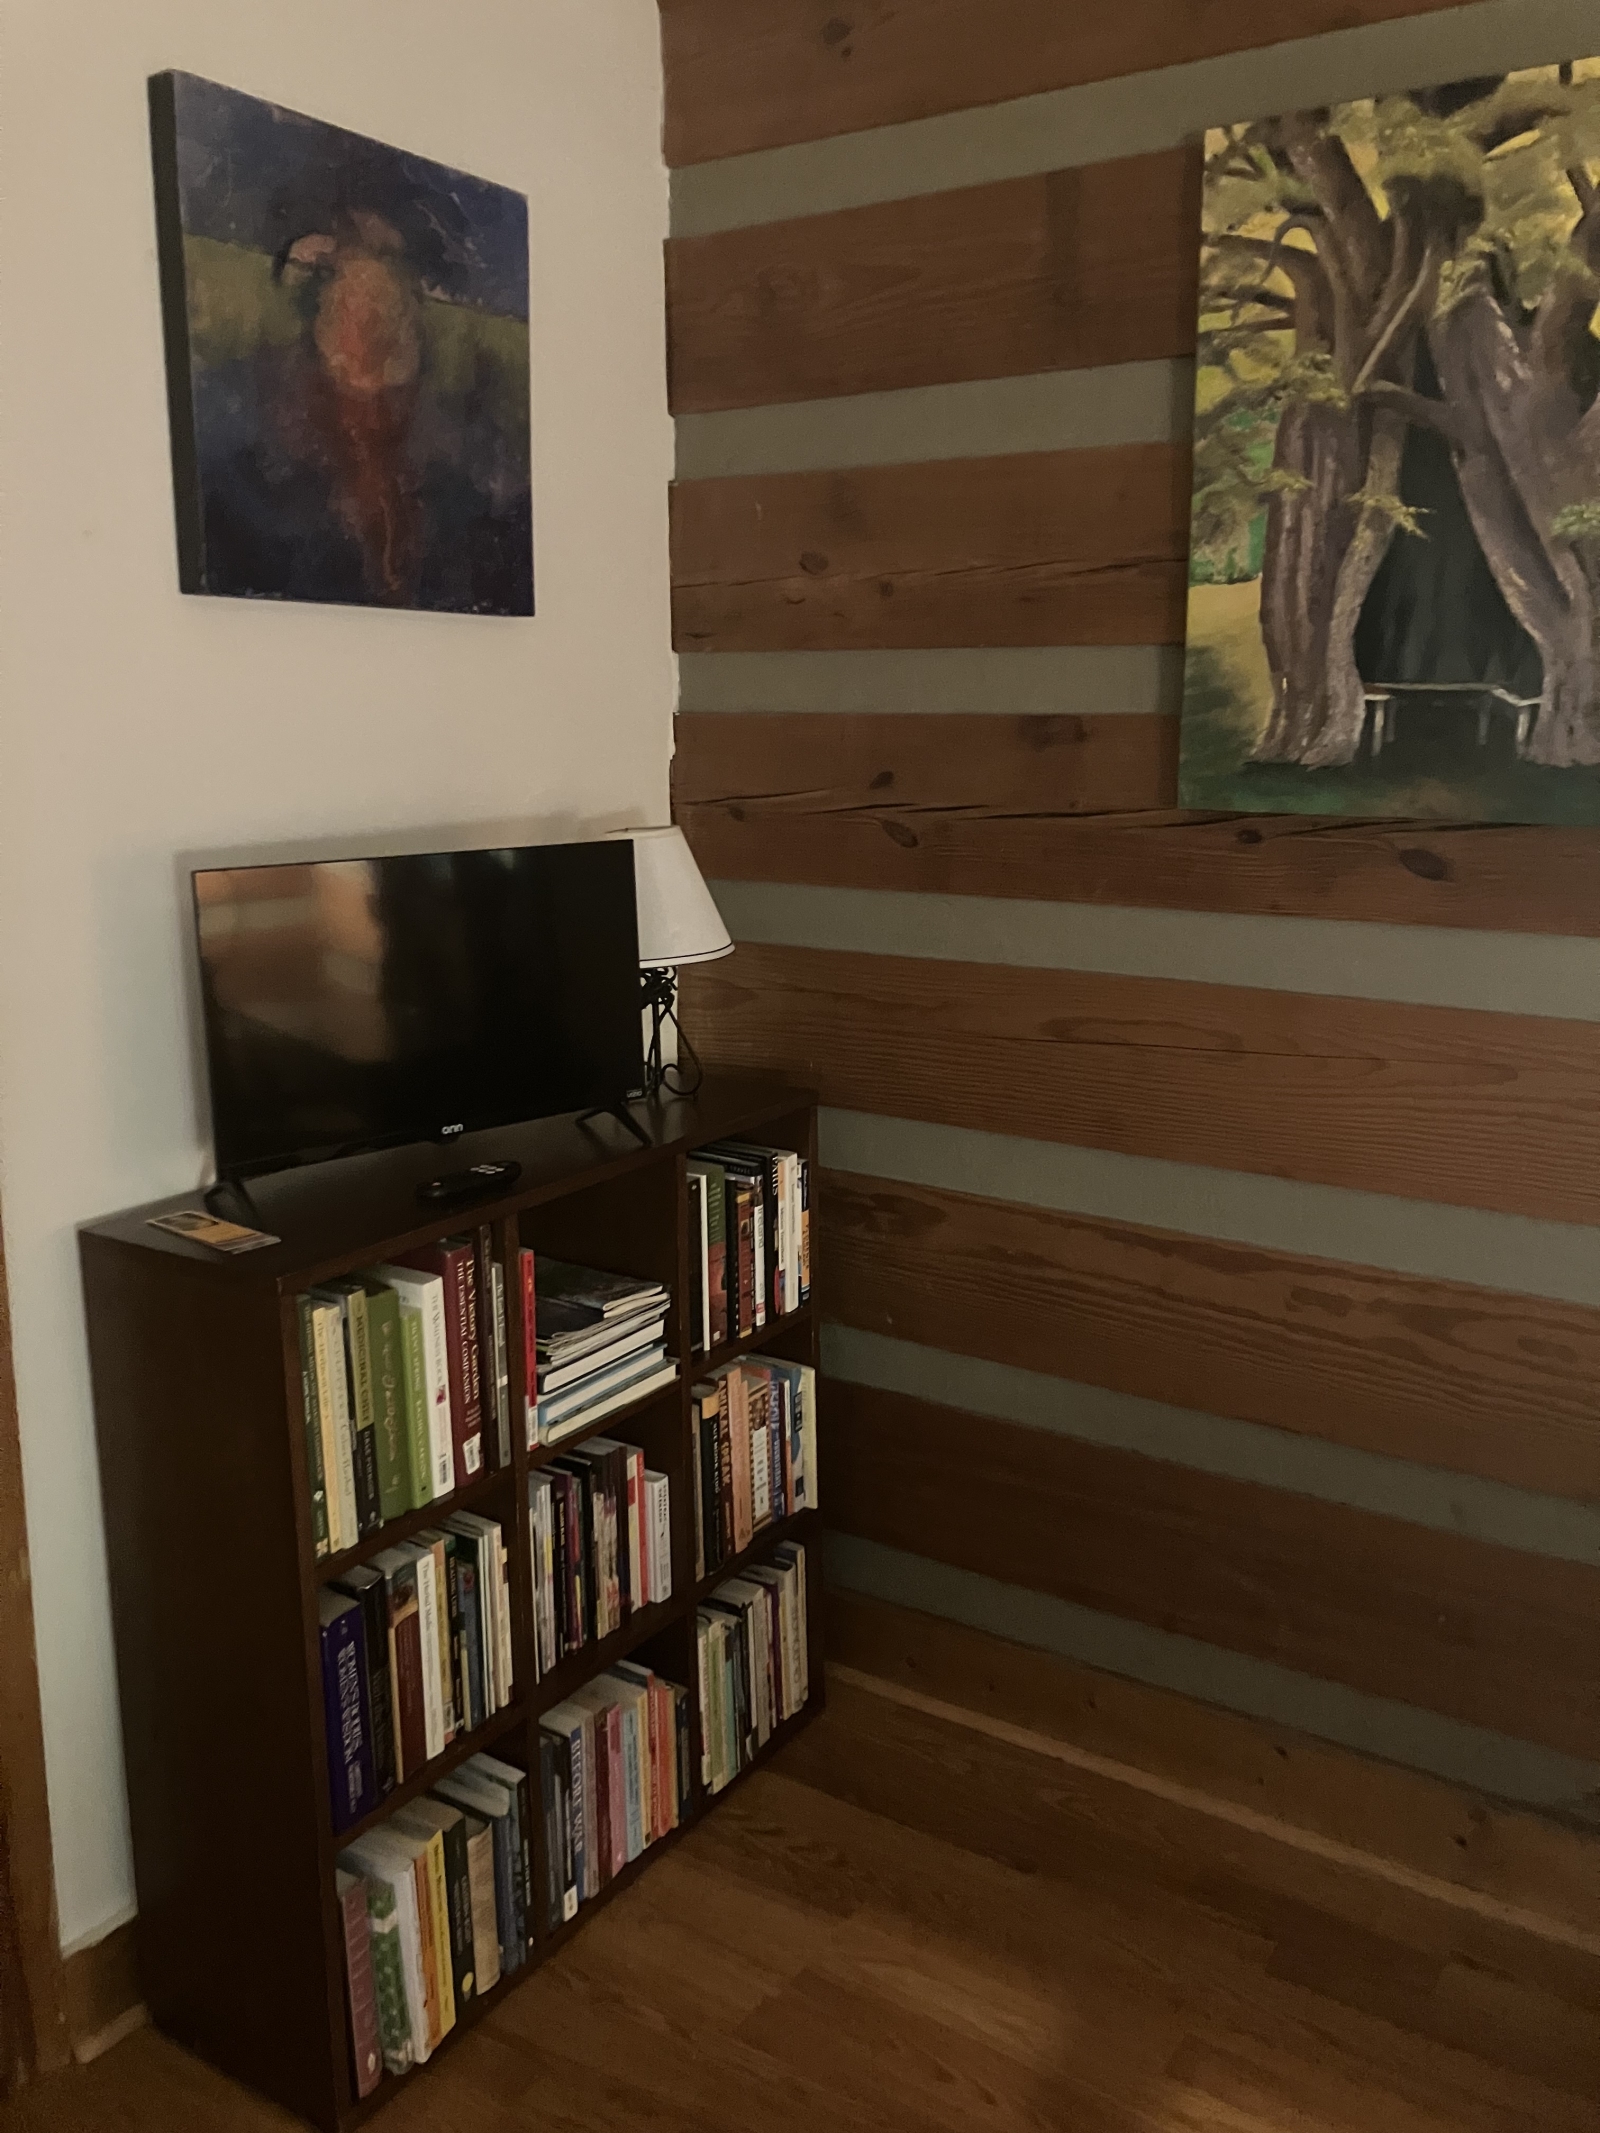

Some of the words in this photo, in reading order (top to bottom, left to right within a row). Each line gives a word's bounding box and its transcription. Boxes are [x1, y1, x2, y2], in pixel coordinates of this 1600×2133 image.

[441, 1123, 464, 1140] onn
[456, 1259, 465, 1282] THE
[466, 1259, 475, 1286] The
[458, 1284, 468, 1338] ESSENTIAL
[467, 1288, 477, 1341] Victory
[413, 1357, 421, 1392] SPRING
[462, 1340, 472, 1405] COMPANION
[471, 1343, 480, 1401] Garden
[718, 1380, 728, 1438] ANIMAL
[721, 1442, 731, 1487] SPEAK
[571, 1738, 581, 1807] BEFORE
[572, 1811, 583, 1856] WAR
